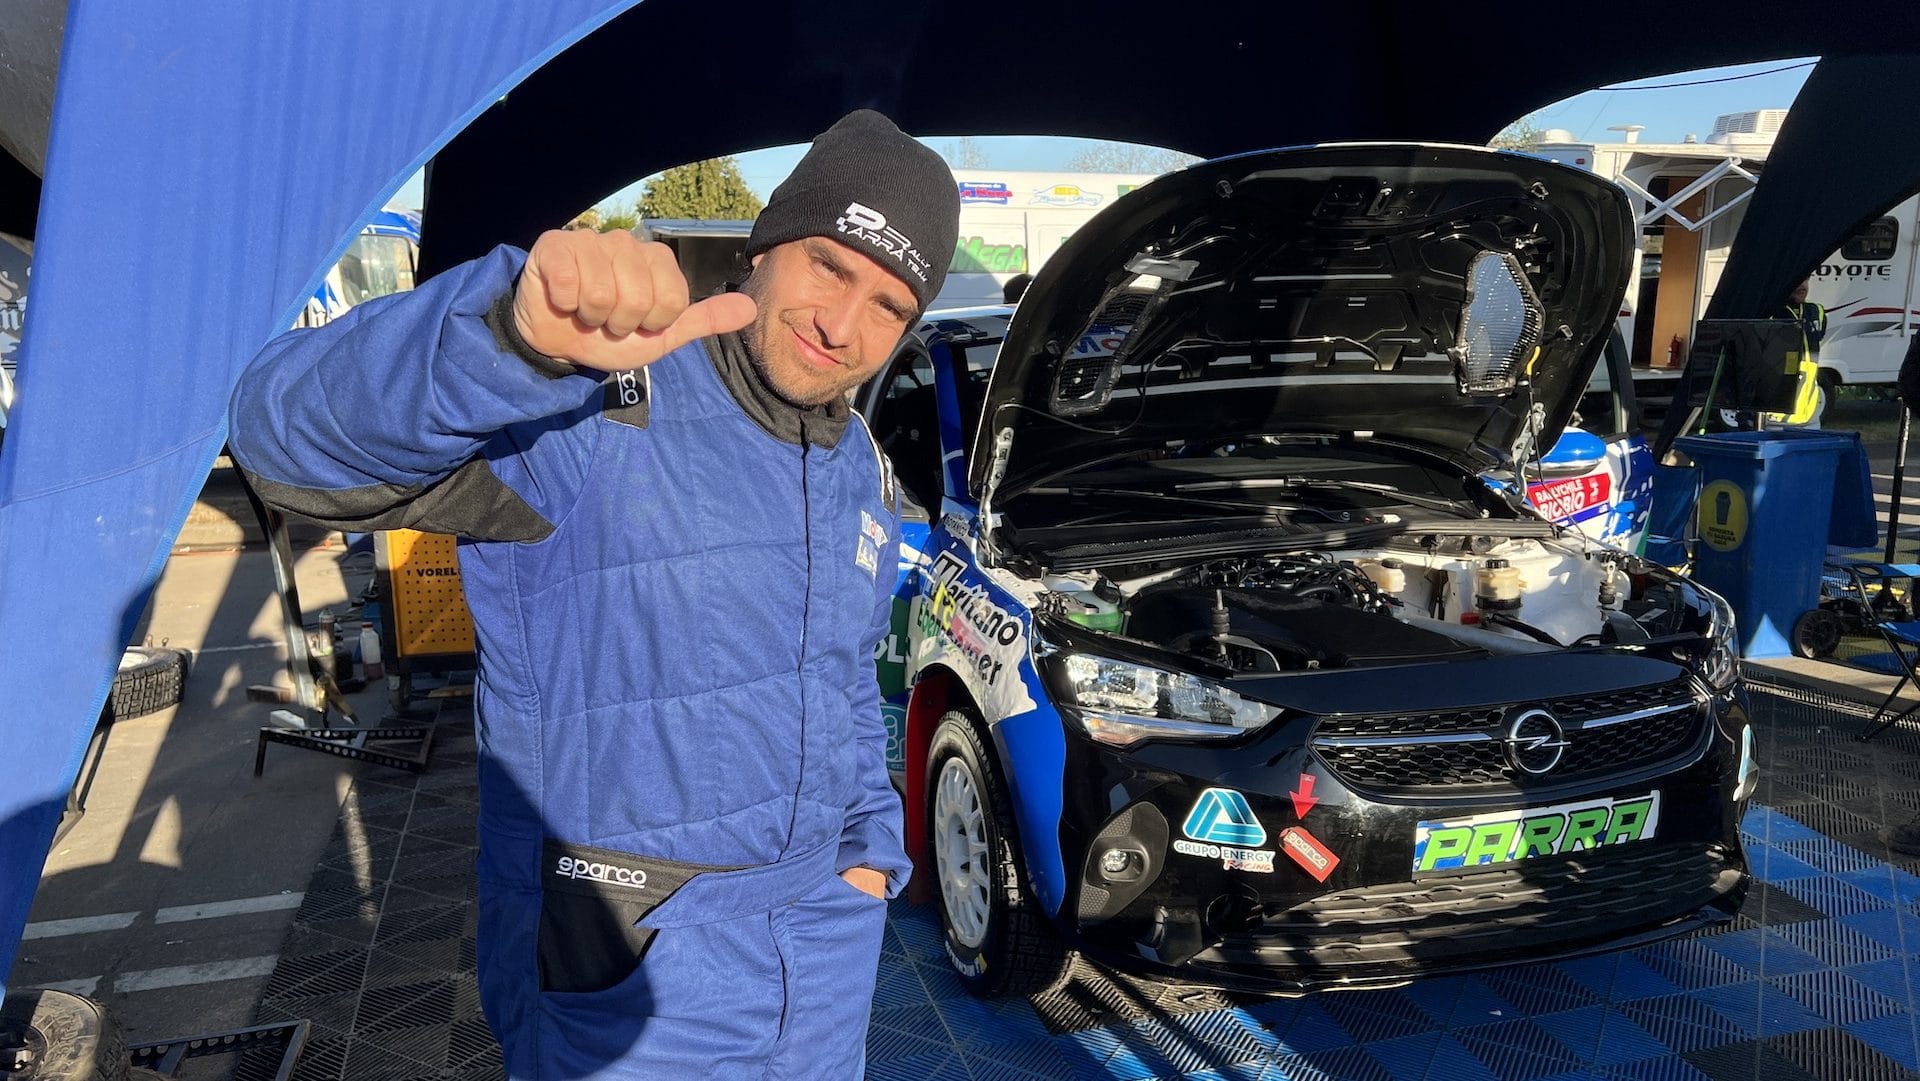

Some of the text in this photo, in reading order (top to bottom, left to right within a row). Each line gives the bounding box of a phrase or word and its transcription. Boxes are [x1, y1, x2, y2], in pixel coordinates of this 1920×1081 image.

[1811, 264, 1892, 277] OYOTE
[1418, 799, 1655, 872] PARRA
[1175, 841, 1273, 863] GRUPO ENERGY
[1283, 830, 1331, 871] sparco
[557, 856, 647, 886] sparco
[1225, 859, 1272, 872] RACING
